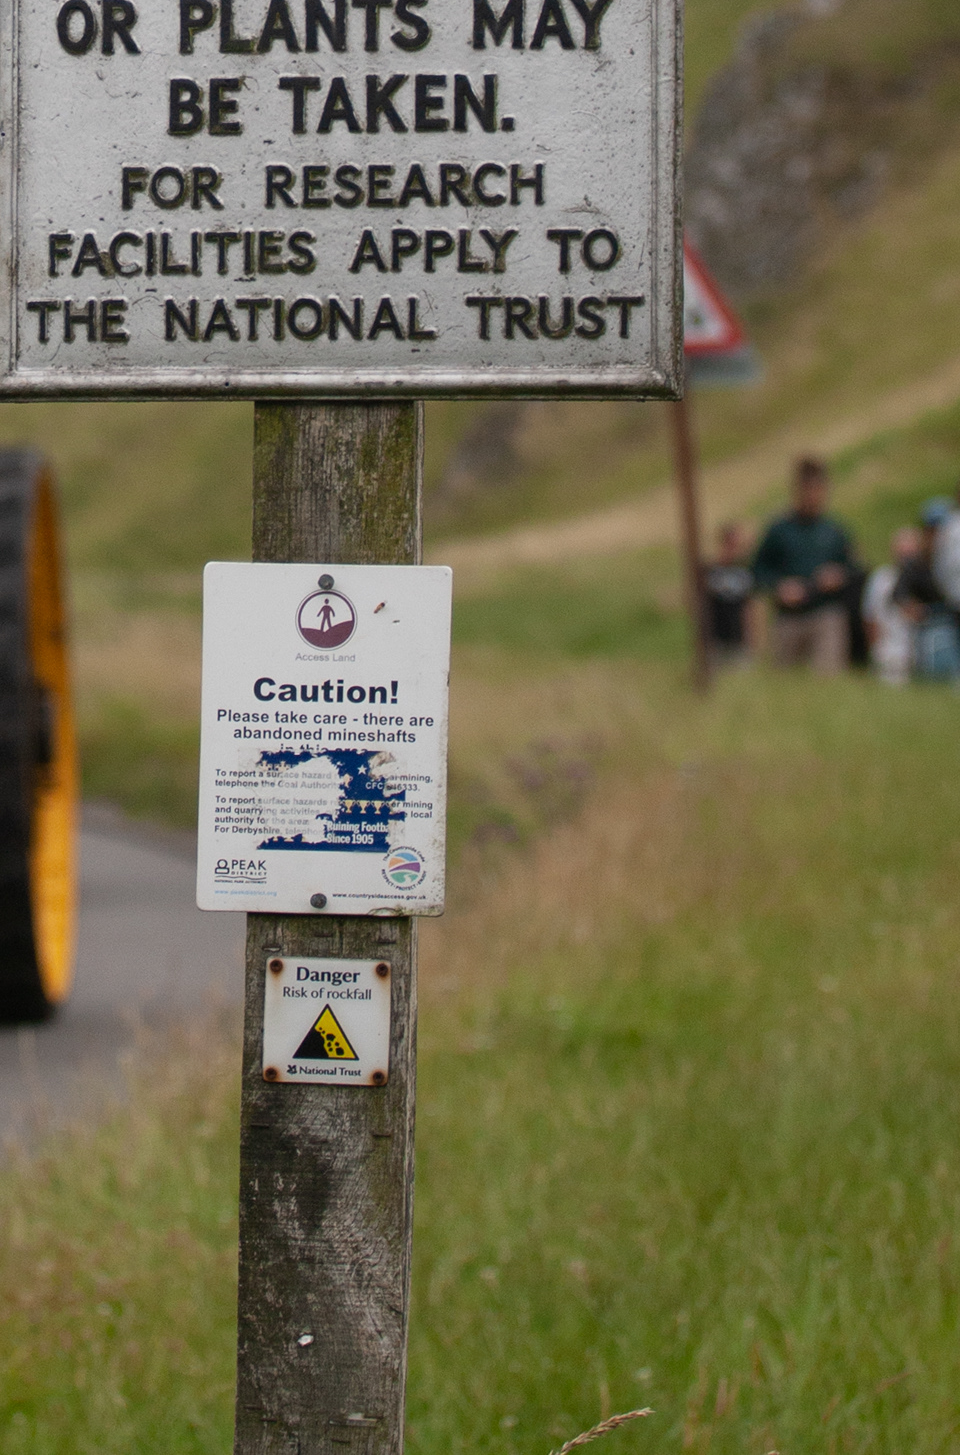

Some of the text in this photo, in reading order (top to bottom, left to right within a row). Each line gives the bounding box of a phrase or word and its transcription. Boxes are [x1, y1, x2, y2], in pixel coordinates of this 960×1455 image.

[167, 73, 516, 136] BE TAKEN.
[121, 162, 546, 210] FOR RESEARCH
[47, 228, 621, 277] FACILITIES APPLY TO
[27, 295, 644, 343] THE NATIONAL TRUST
[295, 652, 356, 663] Access Land
[253, 677, 399, 705] Caution!
[217, 709, 270, 723] Please
[275, 710, 308, 724] take
[313, 714, 347, 725] care
[363, 712, 404, 726] there
[409, 716, 435, 727] are
[233, 726, 417, 743] abandoned mineshafts
[215, 769, 227, 777] To
[229, 770, 256, 779] report
[215, 779, 259, 788] telephone
[215, 795, 226, 803] To
[229, 797, 256, 806] report
[403, 800, 433, 810] mining
[215, 806, 231, 814] and
[214, 816, 254, 825] authority
[327, 833, 374, 845] Since 1905
[231, 859, 267, 871] PEAK
[332, 893, 427, 901] www.countrysideaccess.gov.uk
[296, 966, 361, 986] Danger
[283, 986, 372, 1000] Risk of rockfall
[299, 1066, 362, 1077] National Trust
